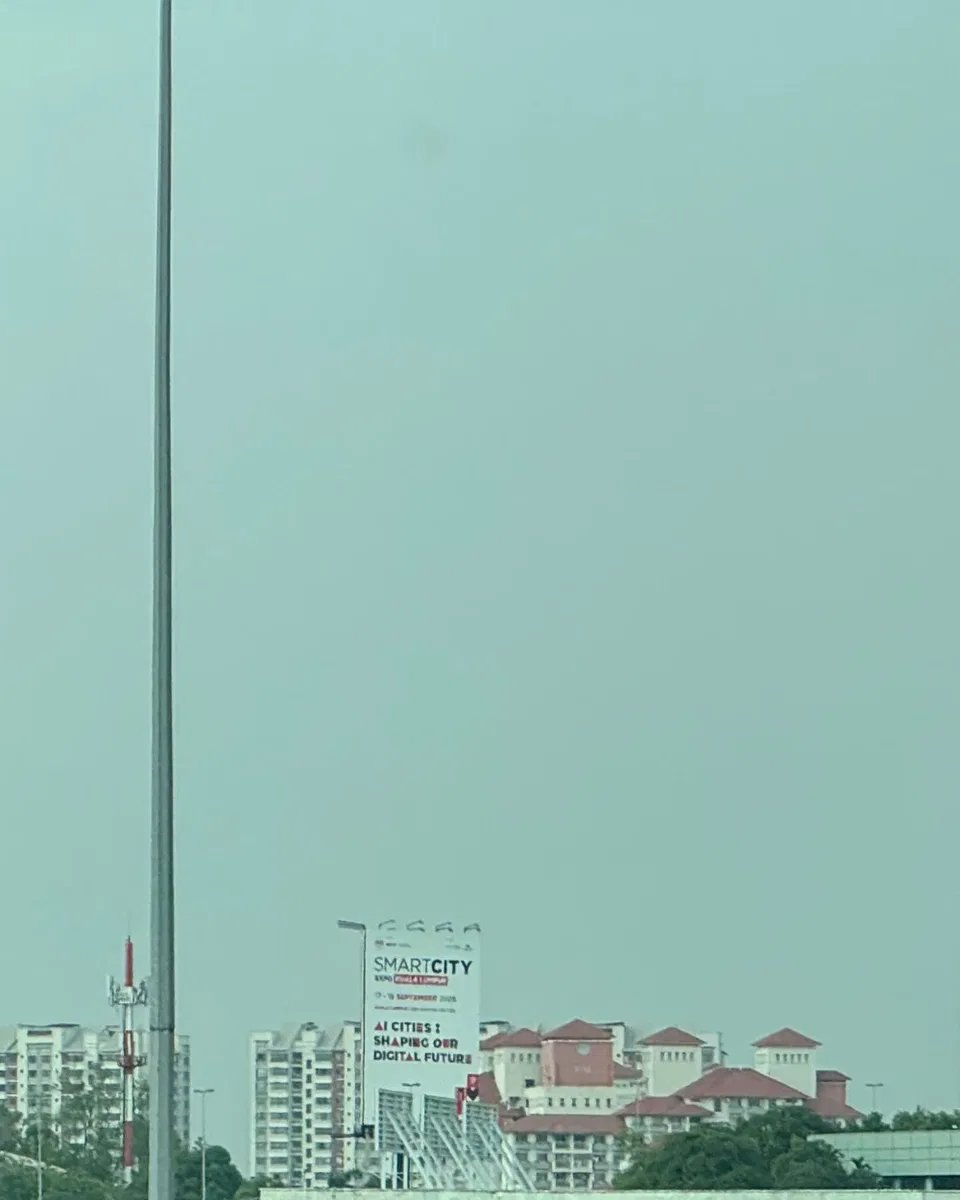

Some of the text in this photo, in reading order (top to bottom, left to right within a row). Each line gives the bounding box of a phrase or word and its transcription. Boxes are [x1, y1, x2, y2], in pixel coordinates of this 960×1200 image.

[374, 1021, 388, 1031] AI
[391, 1022, 432, 1033] CITIES
[373, 1050, 473, 1065] DIGITAL FUTURE
